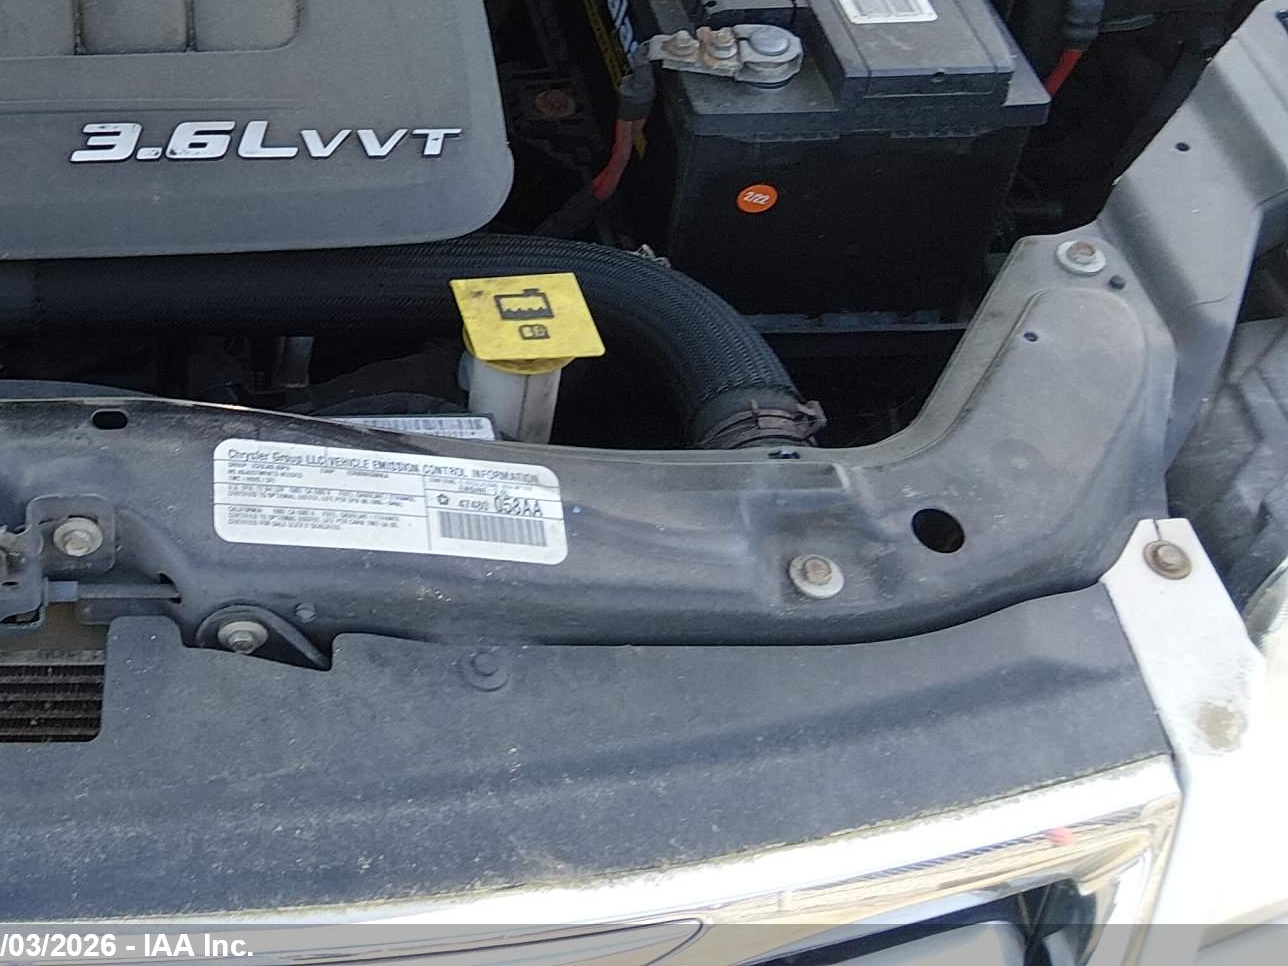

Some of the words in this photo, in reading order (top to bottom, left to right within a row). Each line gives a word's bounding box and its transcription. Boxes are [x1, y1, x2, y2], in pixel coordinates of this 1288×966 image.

[227, 448, 270, 462] Chrysler
[272, 451, 304, 466] Group
[330, 457, 370, 469] VEHICLE
[372, 460, 420, 473] EMISSION
[422, 464, 468, 478] CONTROL
[470, 469, 540, 484] INFORMATION
